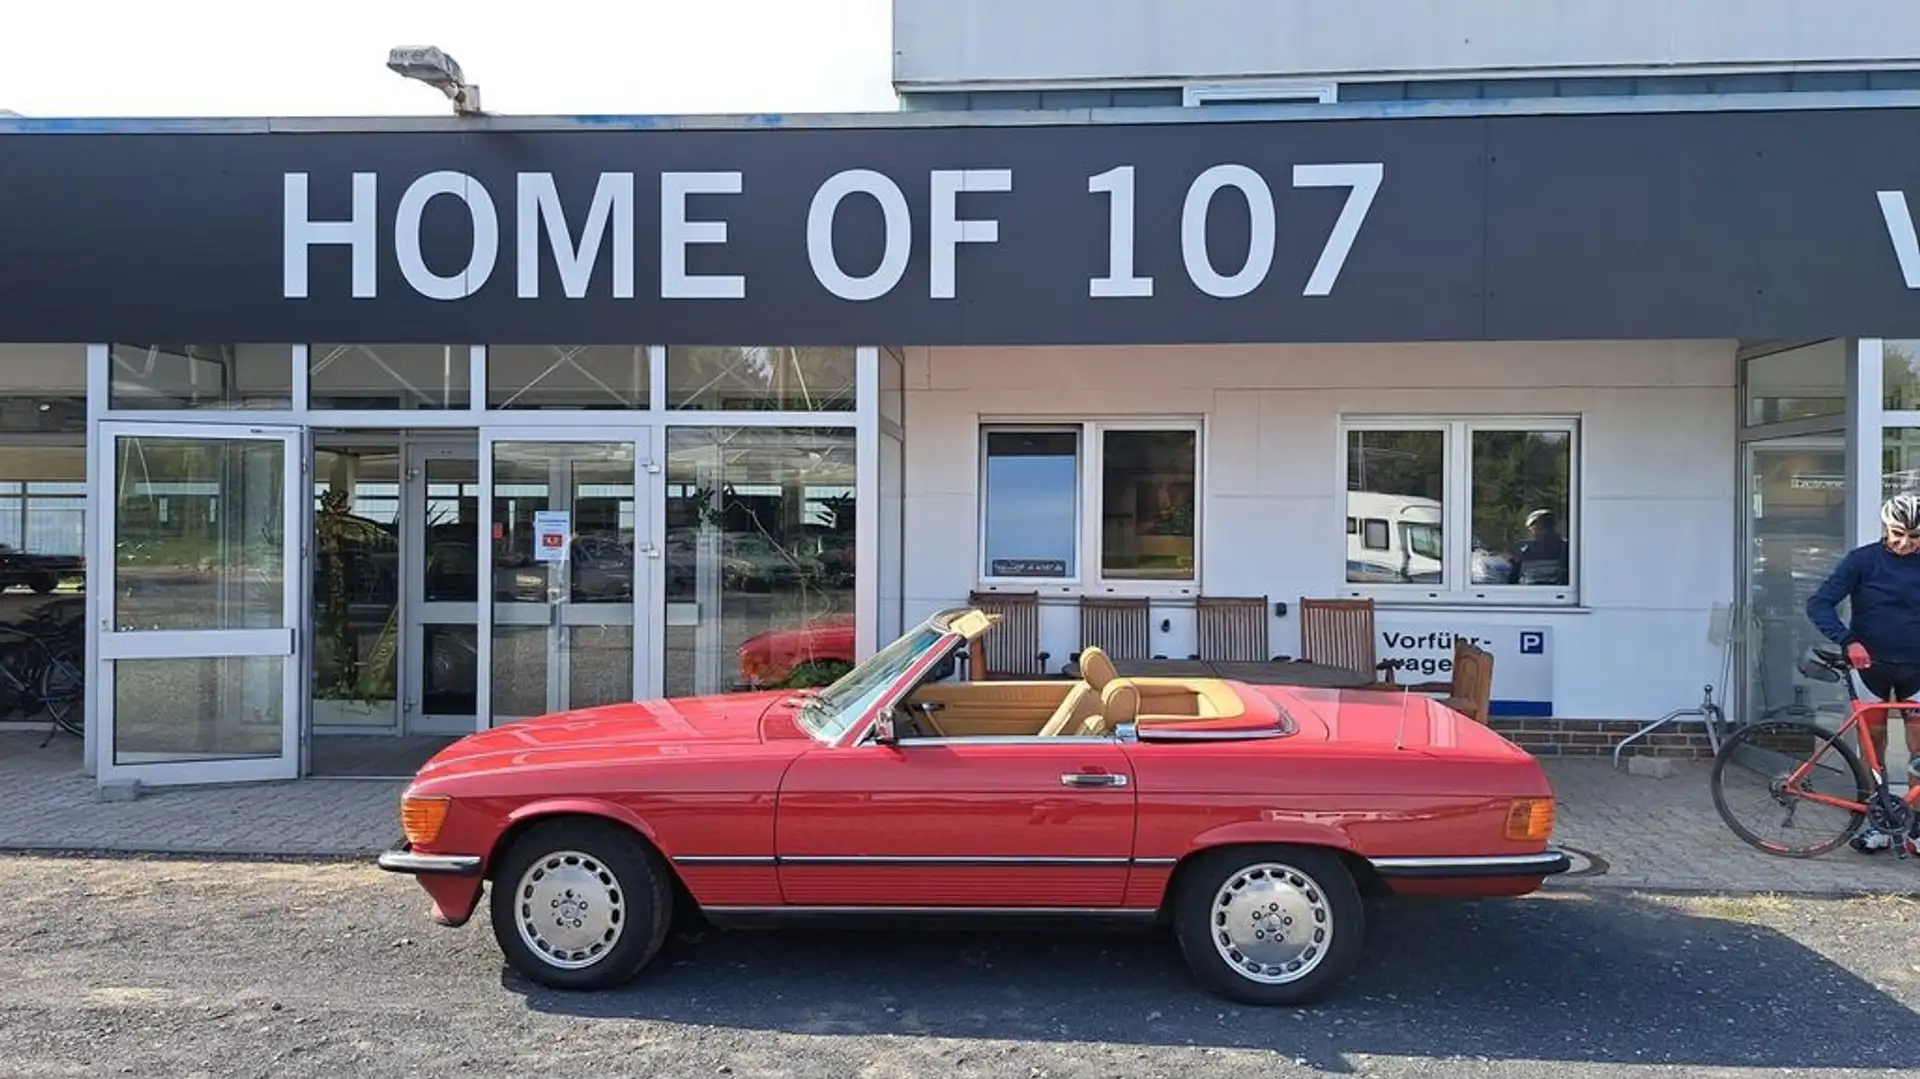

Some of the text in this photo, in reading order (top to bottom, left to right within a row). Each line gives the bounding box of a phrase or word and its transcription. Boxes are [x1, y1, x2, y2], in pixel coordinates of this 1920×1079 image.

[283, 162, 1384, 301] HOME OF 107
[1523, 634, 1540, 652] P
